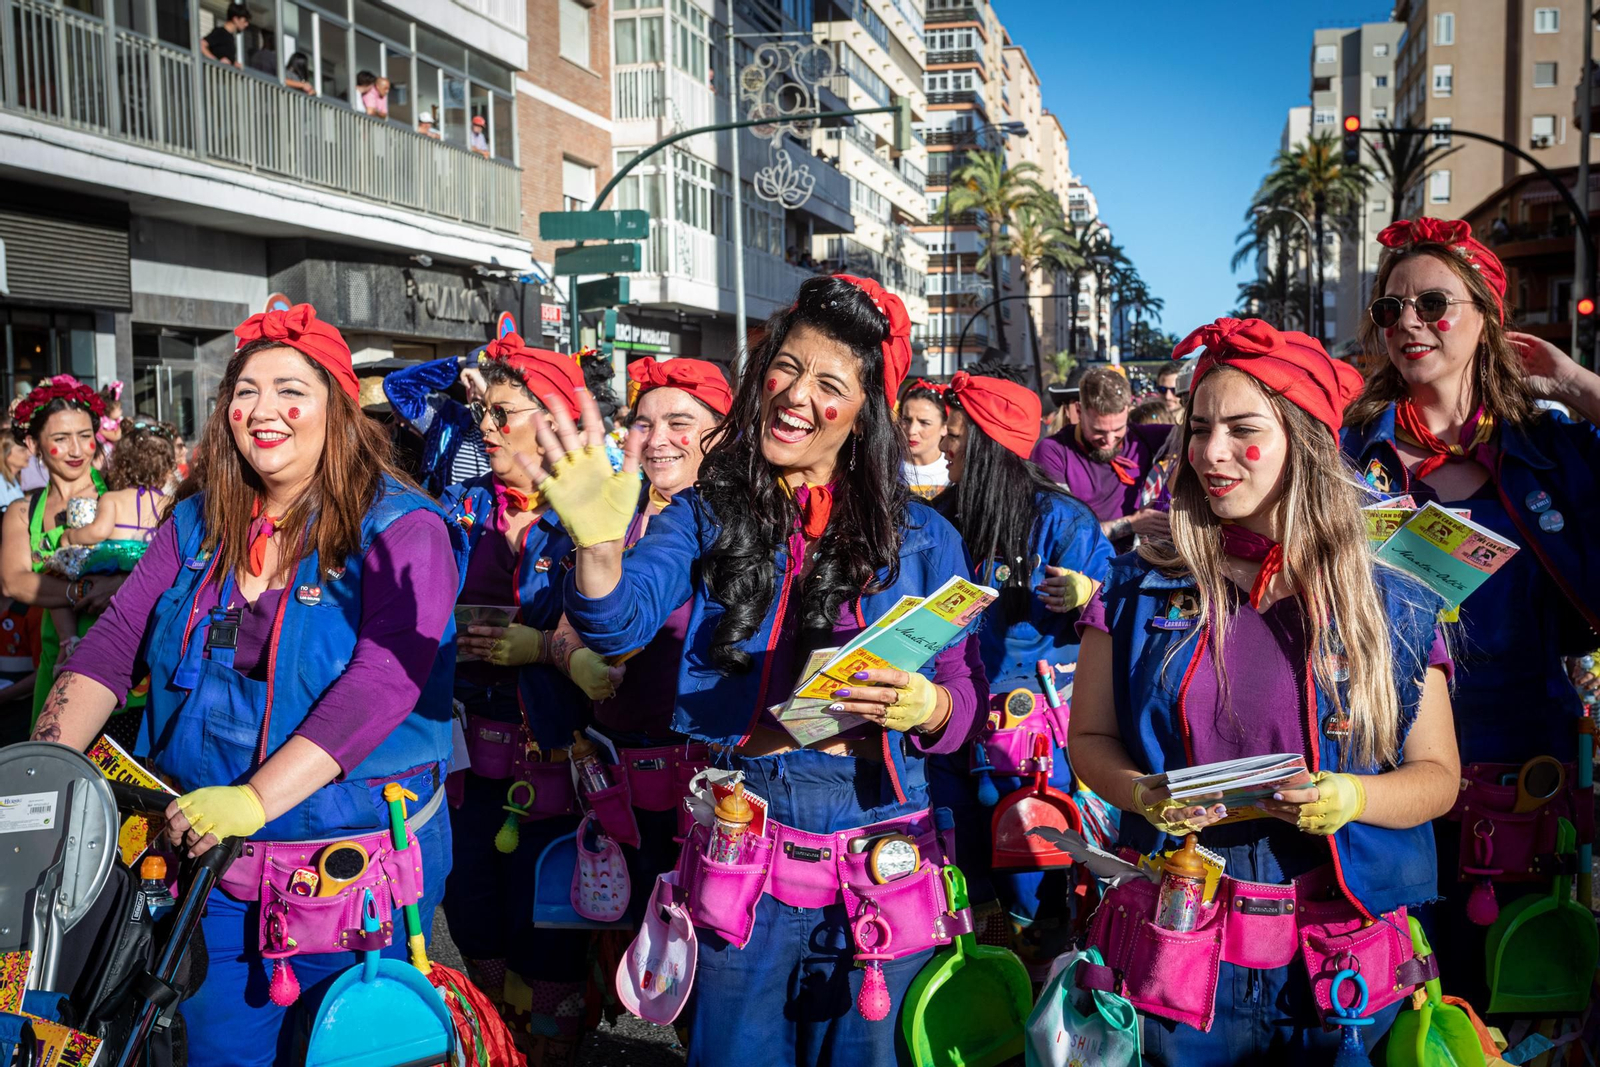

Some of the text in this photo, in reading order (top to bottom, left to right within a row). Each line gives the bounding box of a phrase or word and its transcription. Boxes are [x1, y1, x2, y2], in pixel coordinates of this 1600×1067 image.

[1441, 517, 1453, 526] CAN
[1485, 541, 1498, 549] CAN
[1391, 547, 1432, 573] Marta
[99, 755, 121, 776] WE
[127, 762, 153, 785] COMPARSA
[1070, 1033, 1105, 1057] SHINE
